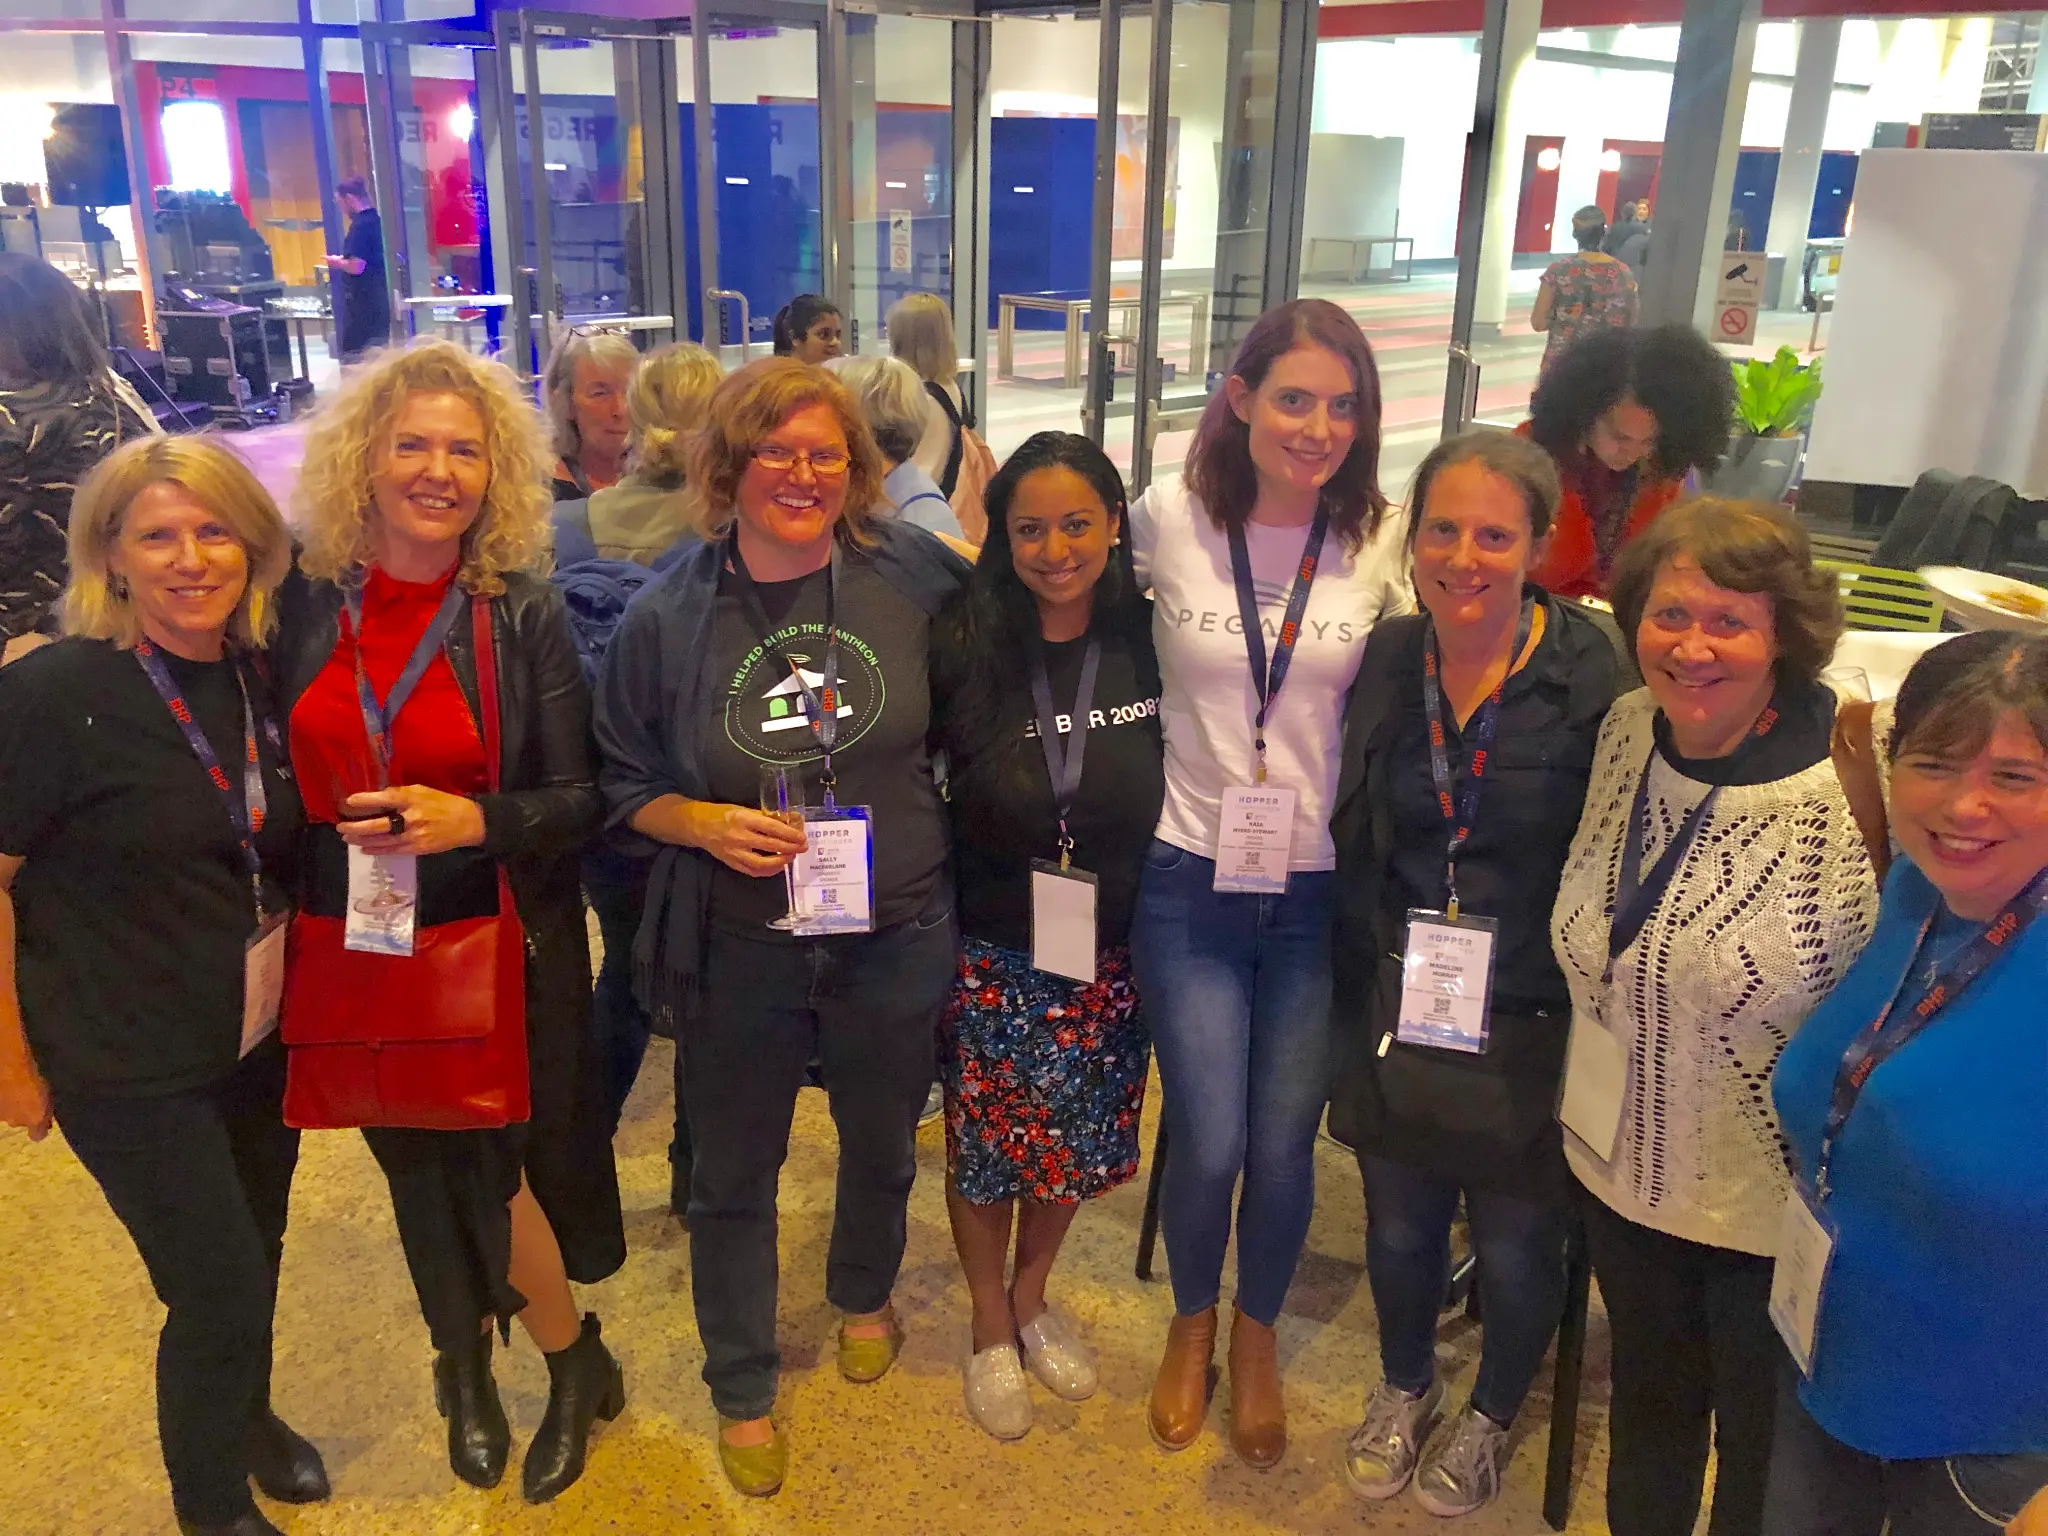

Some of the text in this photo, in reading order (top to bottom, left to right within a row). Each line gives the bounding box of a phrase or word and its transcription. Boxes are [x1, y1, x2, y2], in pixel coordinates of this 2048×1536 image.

[1301, 556, 1315, 581] BHP
[1177, 608, 1353, 643] PEGAYS
[1281, 621, 1297, 647] BHP
[731, 645, 764, 689] HELPED
[763, 626, 799, 649] BUILD
[801, 623, 825, 634] THE
[1425, 652, 1437, 677] BHP
[169, 697, 193, 724] BHP
[824, 688, 835, 712] BHP
[1431, 720, 1444, 747] BHP
[1471, 750, 1487, 777] BHP
[209, 765, 232, 791] BHP
[1238, 796, 1279, 805] HOPPER
[1439, 791, 1455, 818] BHP
[807, 829, 850, 838] HOPPER
[1428, 934, 1473, 947] HOPPER
[1985, 912, 2018, 946] BHP
[1429, 962, 1464, 973] MADELINE
[1917, 984, 1945, 1017] BHP
